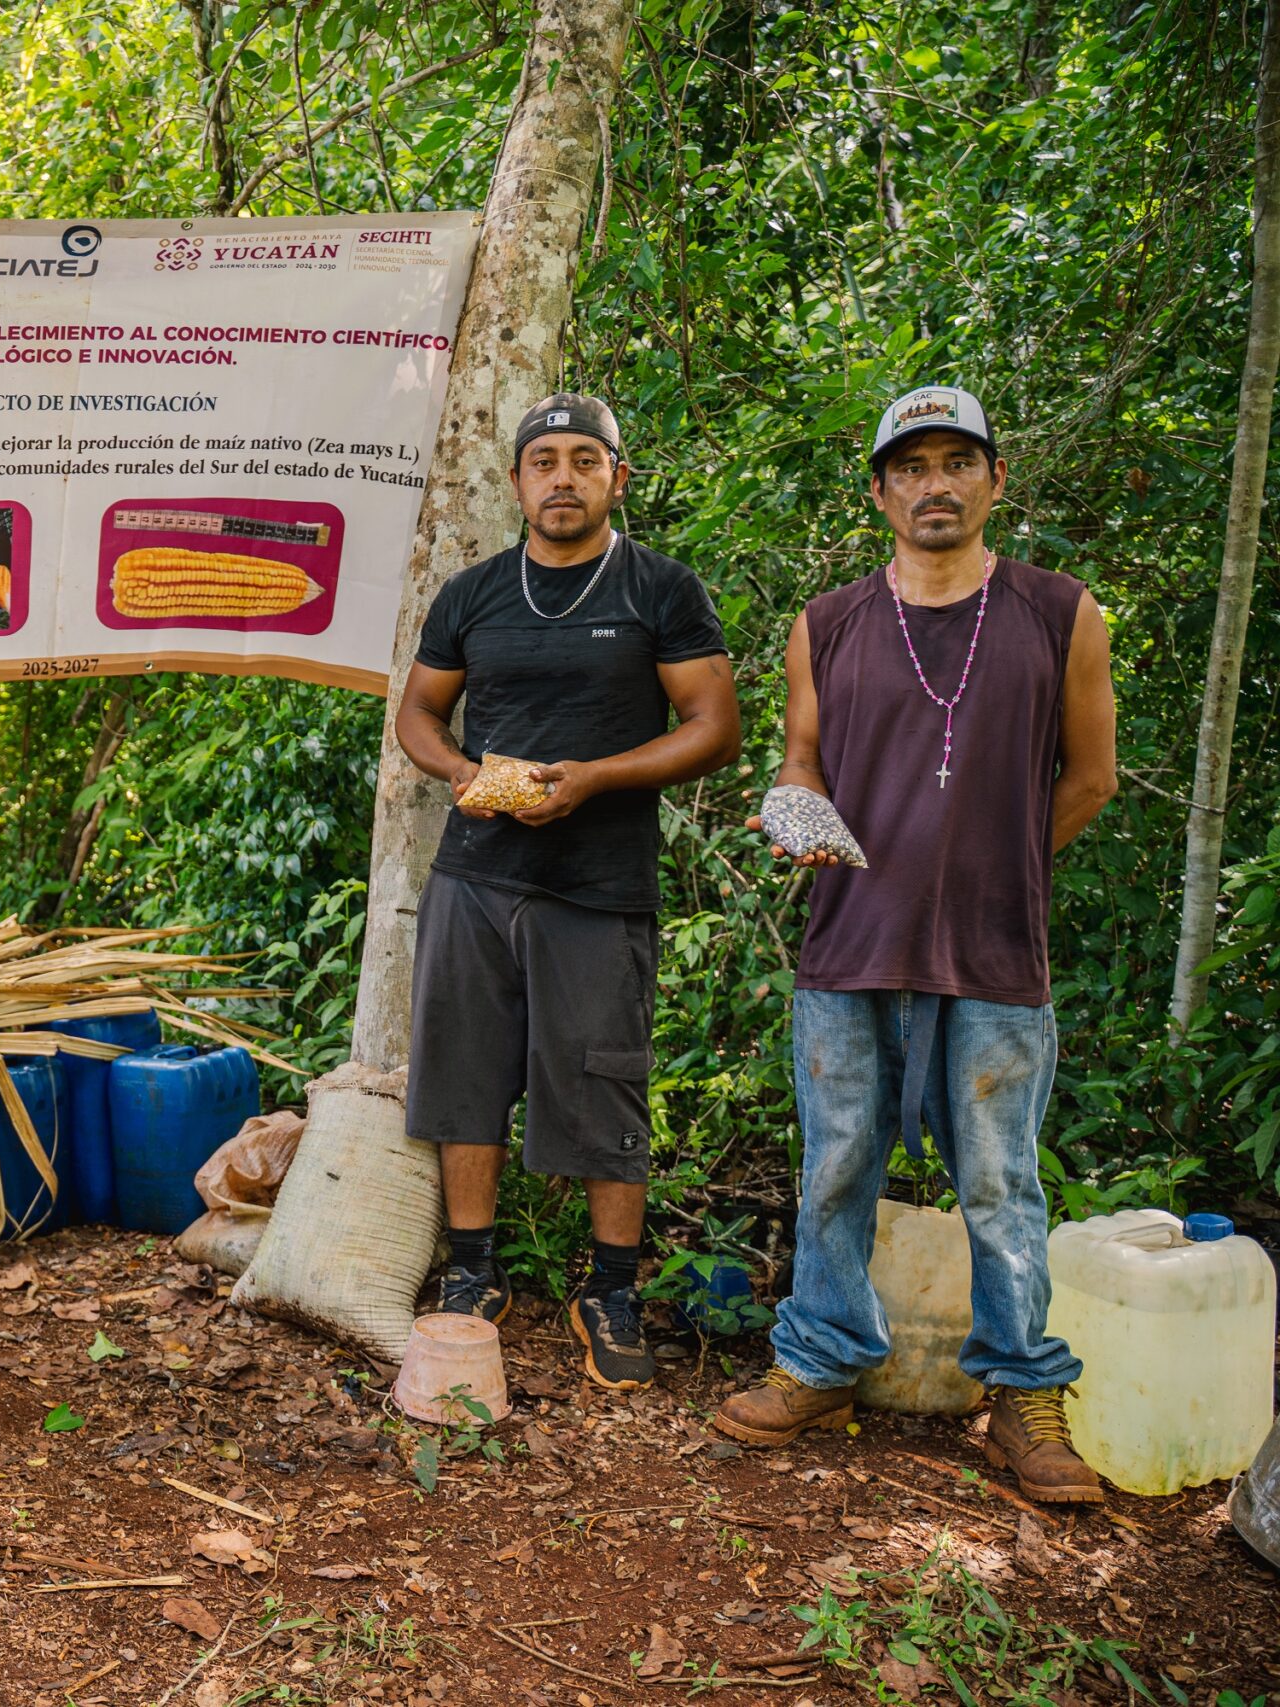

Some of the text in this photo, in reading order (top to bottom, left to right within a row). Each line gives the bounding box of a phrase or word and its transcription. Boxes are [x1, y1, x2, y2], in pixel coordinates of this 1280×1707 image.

[358, 231, 432, 245] SECIHTI
[213, 243, 340, 261] YUCATÁN
[130, 326, 157, 341] AL
[163, 326, 327, 344] CONOCIMIENTO
[332, 329, 453, 354] CIENTÍFICO,
[79, 348, 92, 363] E
[98, 346, 237, 366] INNOVACIÓN.
[37, 395, 64, 411] DE
[69, 391, 218, 412] INVESTIGACIÓN
[913, 392, 933, 401] CAC
[57, 434, 72, 450] la
[77, 434, 174, 454] producción
[179, 434, 200, 450] de
[205, 434, 245, 450] maíz
[250, 436, 302, 451] nativo
[307, 437, 345, 457] (Zea
[350, 442, 393, 461] mays
[398, 444, 420, 466] L.)
[114, 459, 174, 475] rurales
[179, 459, 205, 475] del
[210, 459, 239, 475] Sur
[243, 459, 269, 475] del
[274, 461, 329, 478] estado
[334, 463, 355, 479] de
[359, 464, 425, 489] Yucatán
[22, 658, 99, 676] 2025-2027
